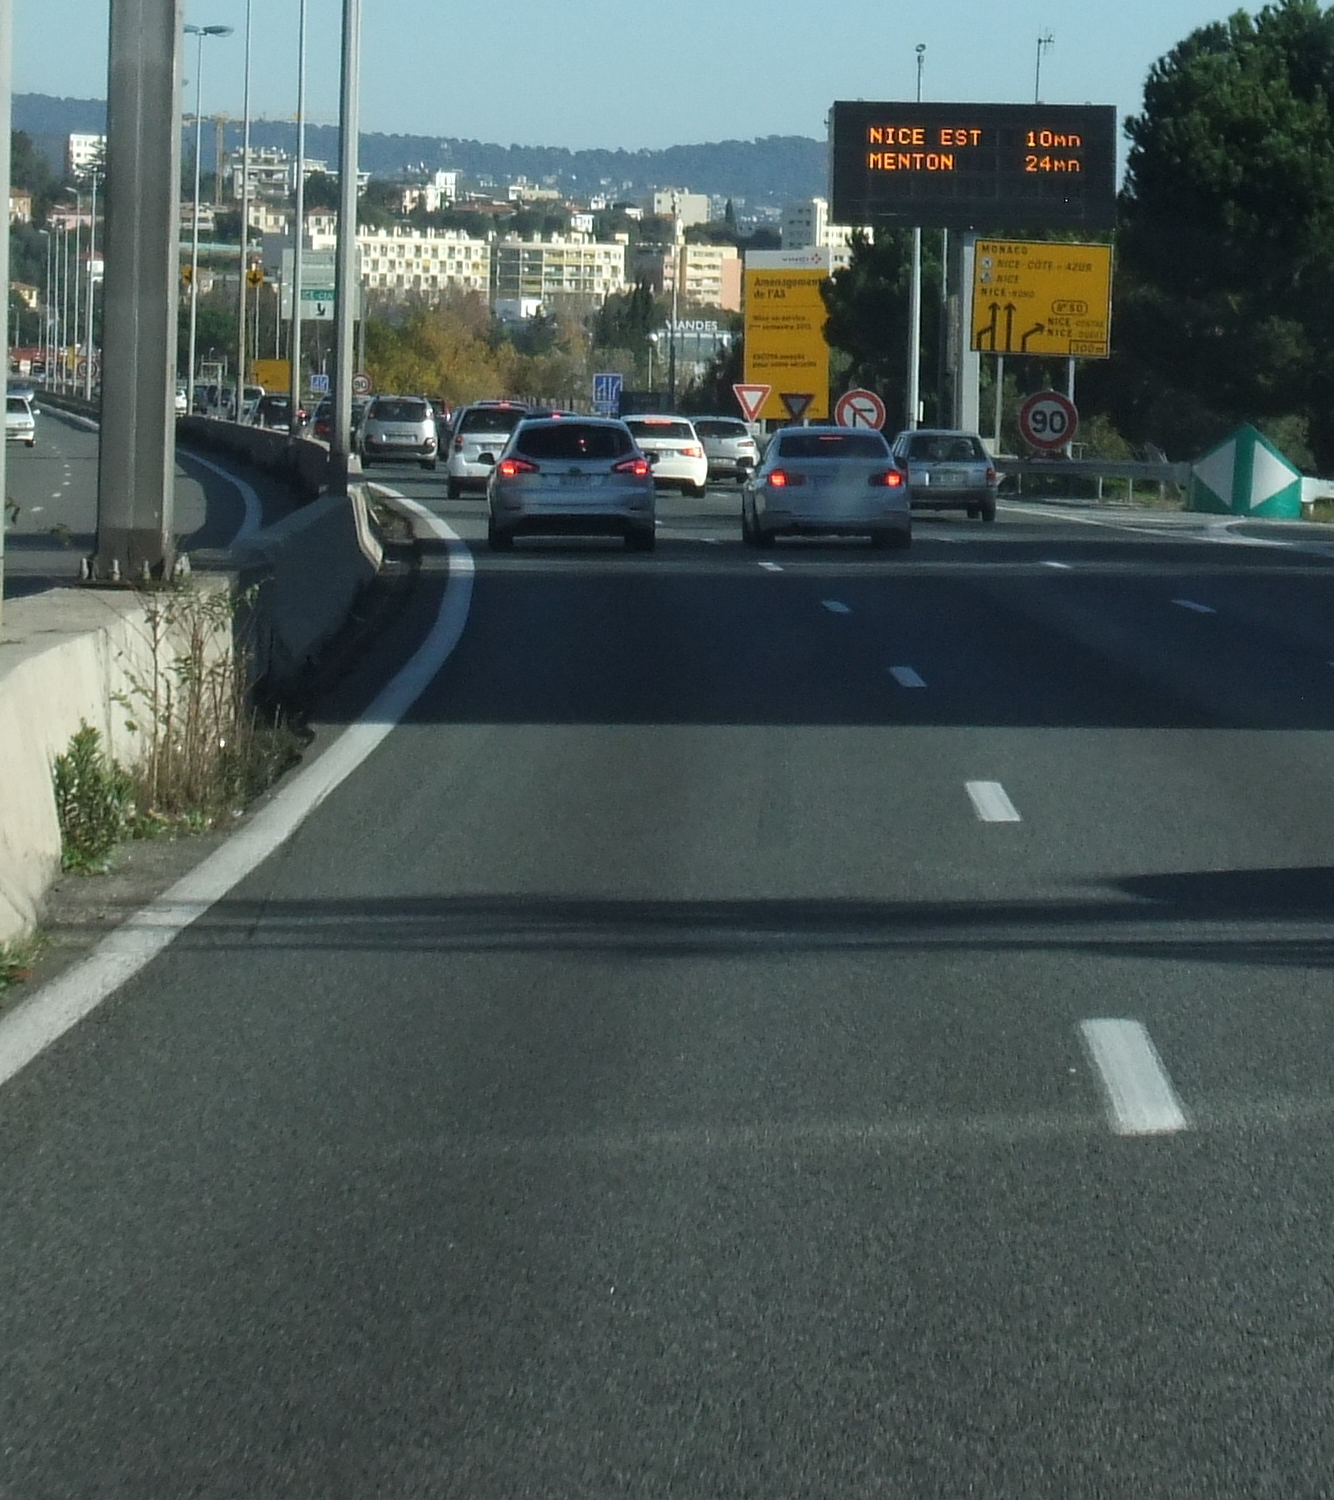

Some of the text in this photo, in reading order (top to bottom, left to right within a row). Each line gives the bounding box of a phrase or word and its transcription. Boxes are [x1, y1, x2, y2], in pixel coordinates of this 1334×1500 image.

[868, 127, 925, 146] NICE
[940, 129, 982, 146] EST
[869, 153, 954, 171] MENTON
[982, 244, 1028, 254] MONACO
[1031, 410, 1067, 434] 90
